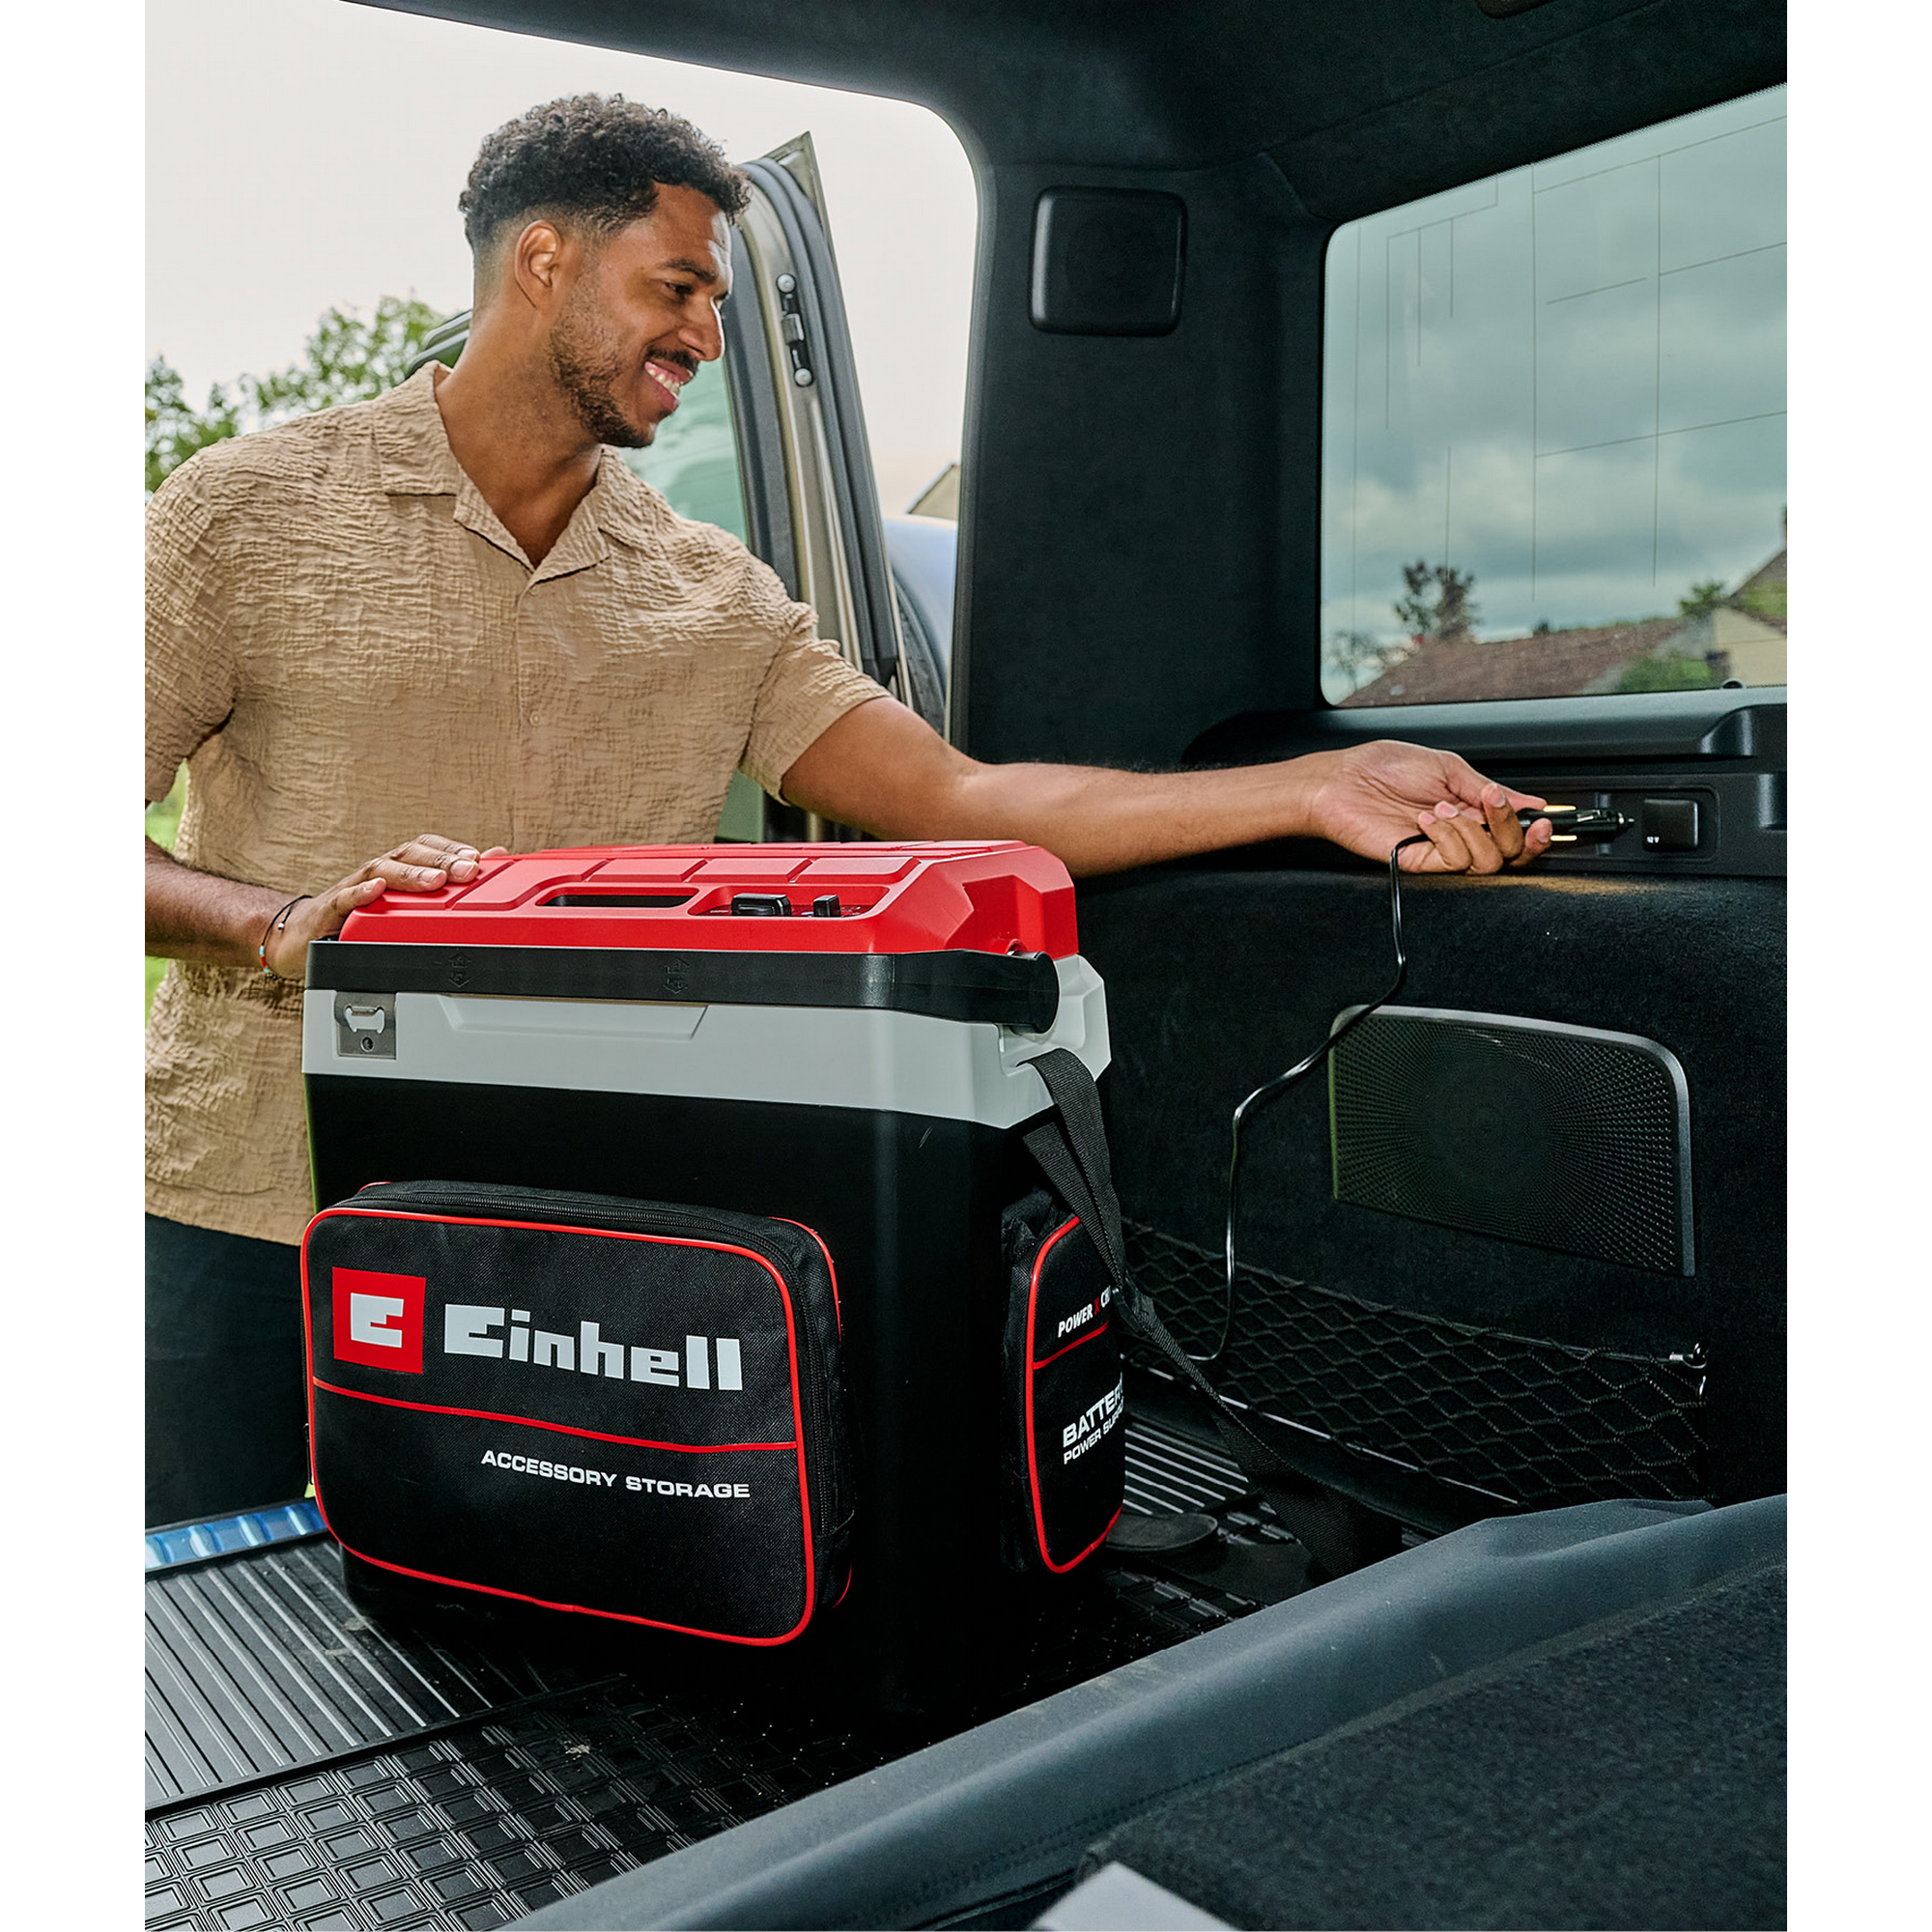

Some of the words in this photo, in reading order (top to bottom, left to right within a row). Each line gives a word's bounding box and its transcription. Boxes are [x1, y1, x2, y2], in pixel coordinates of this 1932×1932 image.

[1058, 1303, 1094, 1338] POWER
[443, 1303, 743, 1390] Einhell
[1064, 1428, 1101, 1464] POWER
[481, 1450, 616, 1487] ACCESSORY
[625, 1476, 751, 1498] STORAGE
